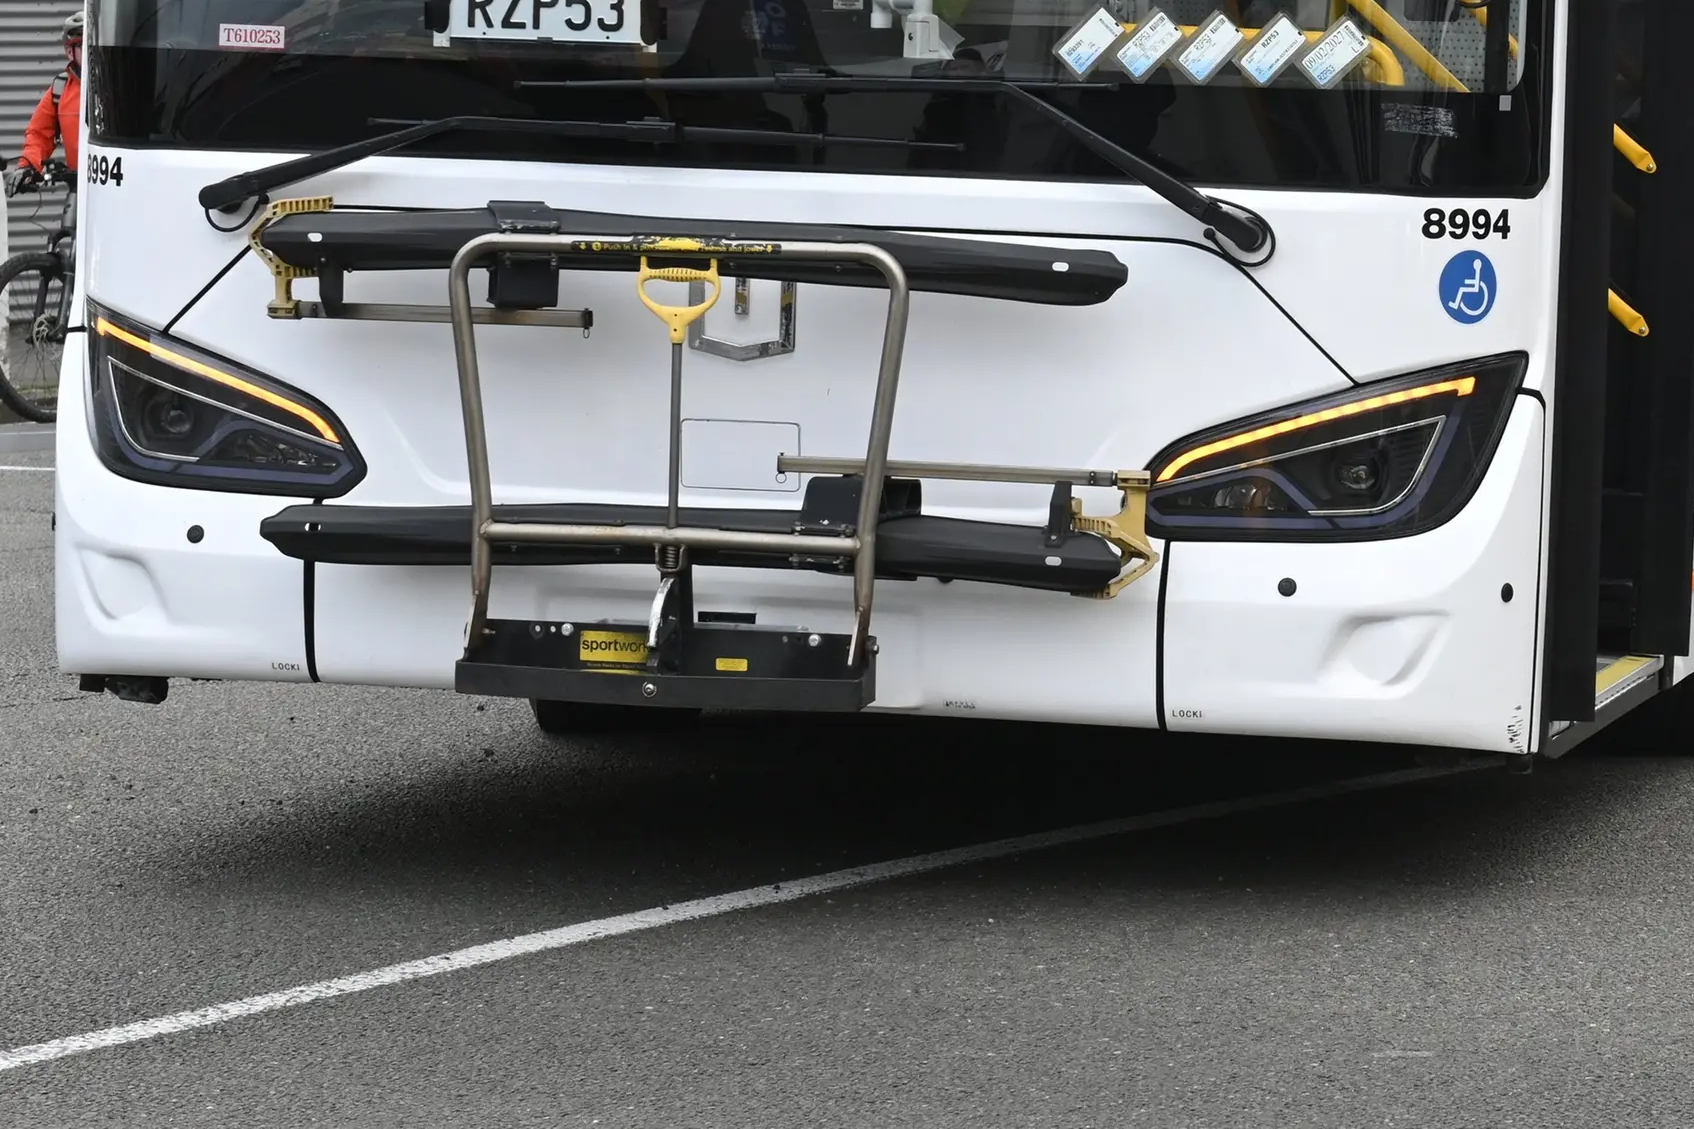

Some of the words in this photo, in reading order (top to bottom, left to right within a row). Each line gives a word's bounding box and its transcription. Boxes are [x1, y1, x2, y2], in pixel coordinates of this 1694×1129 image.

[223, 27, 281, 44] T610253
[1260, 29, 1280, 49] RZP53
[1304, 30, 1345, 70] 09/02/2027
[1316, 64, 1336, 82] RZP53
[1421, 208, 1511, 240] 8994
[582, 639, 649, 652] sportwork
